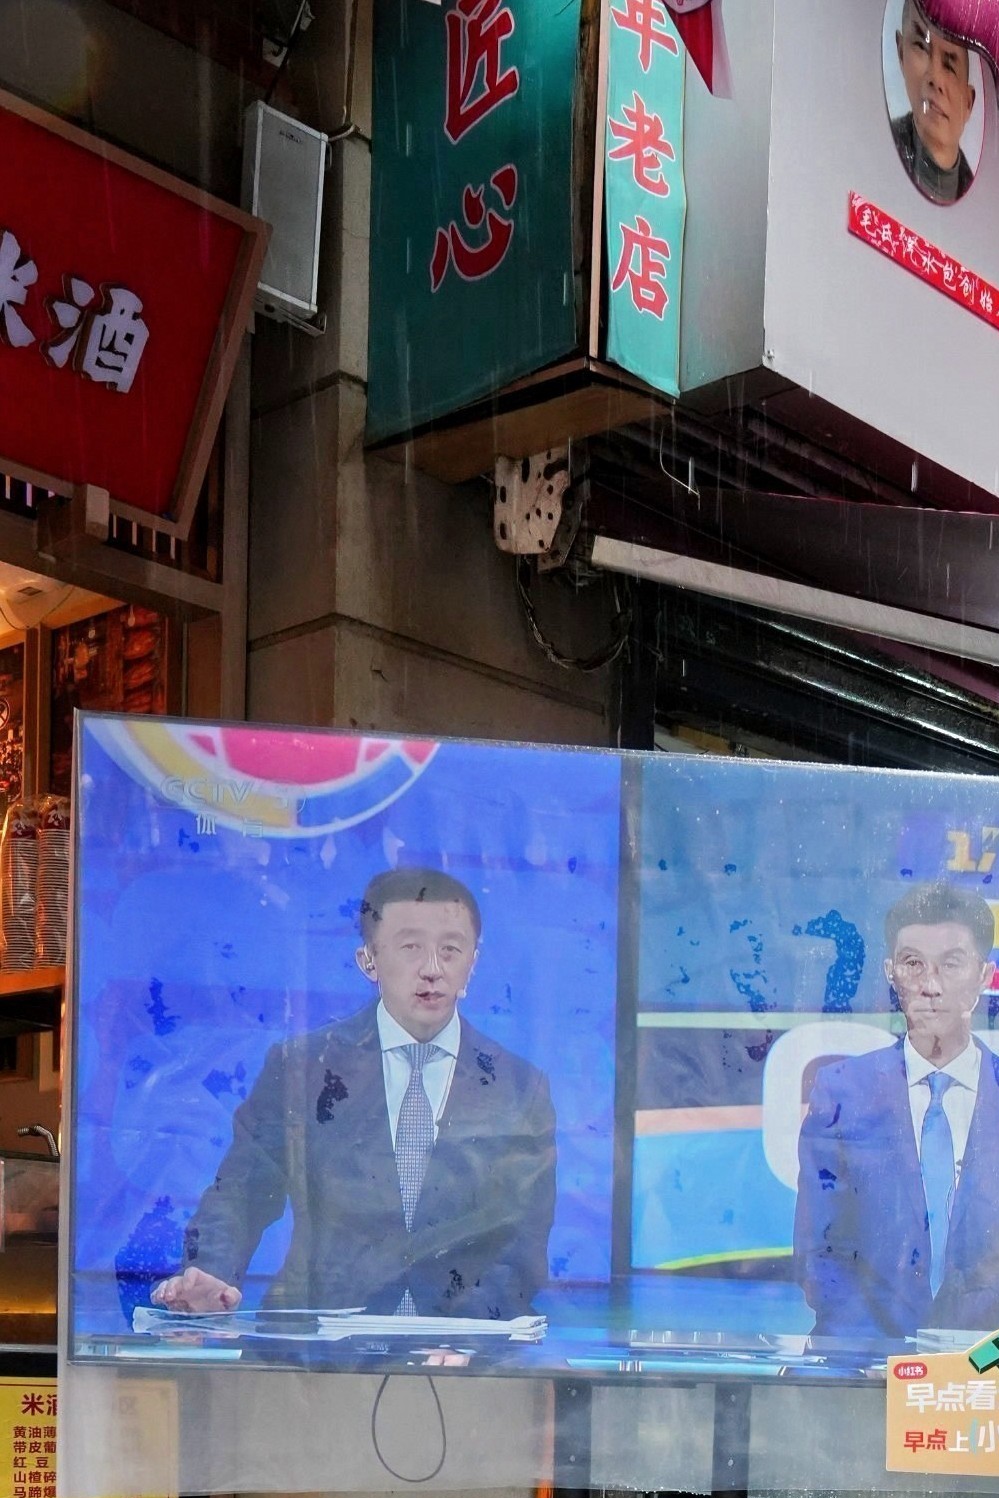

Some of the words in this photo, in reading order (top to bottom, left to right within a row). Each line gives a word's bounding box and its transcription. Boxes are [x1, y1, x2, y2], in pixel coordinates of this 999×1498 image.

[430, 0, 520, 293] 匠心
[897, 1366, 924, 1377] 小红书
[13, 1471, 57, 1484] 山楂碎
